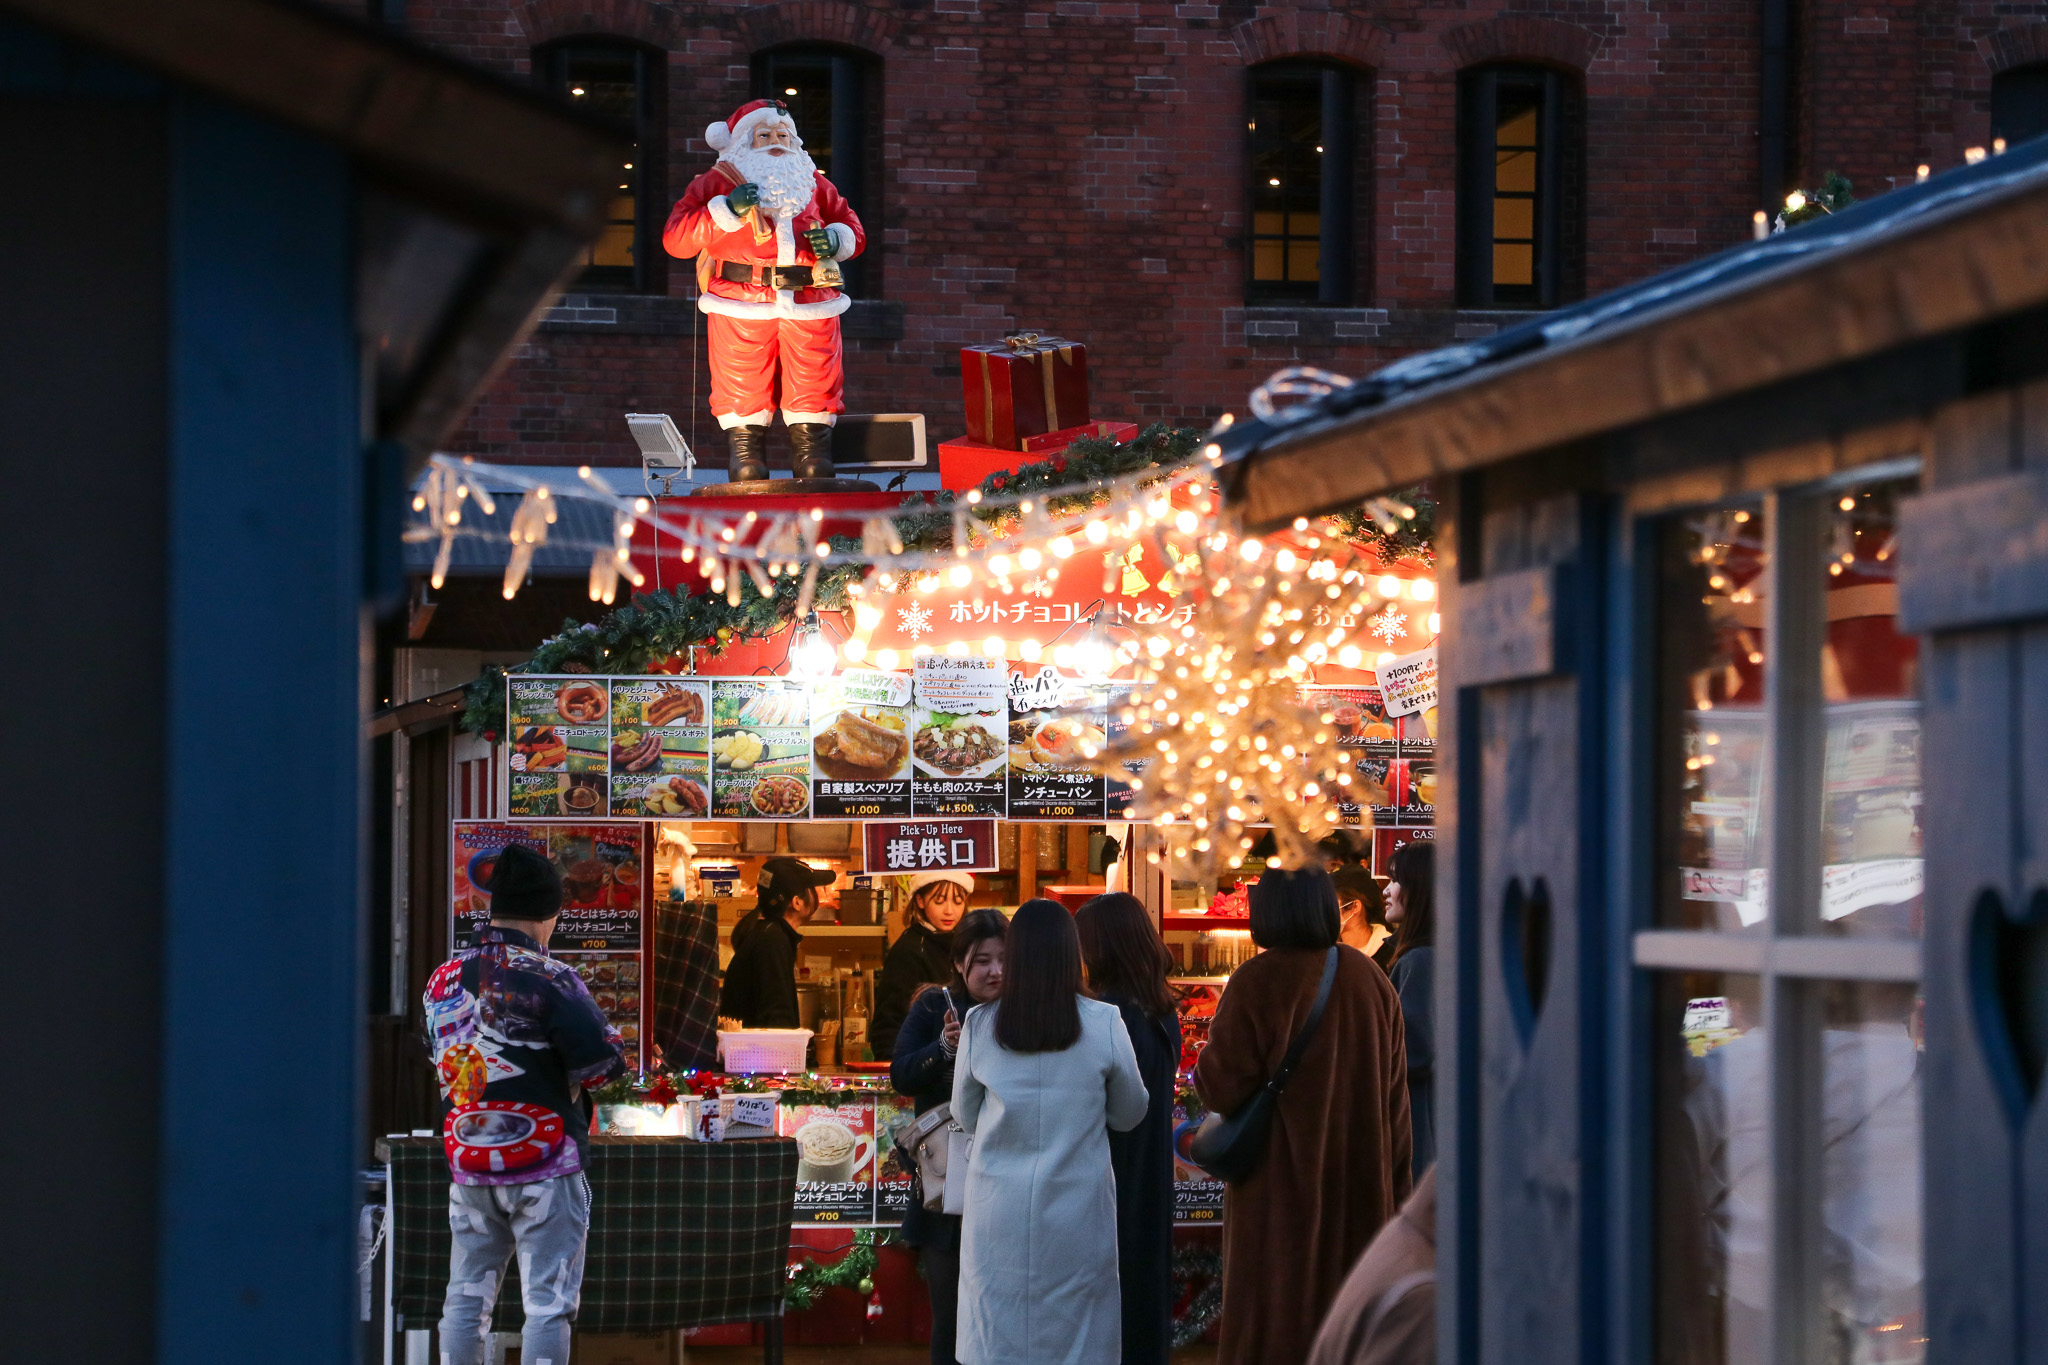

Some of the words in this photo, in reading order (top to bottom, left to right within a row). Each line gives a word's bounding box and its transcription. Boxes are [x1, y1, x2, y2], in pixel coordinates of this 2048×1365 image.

[949, 601, 1197, 624] ホットチョコレトとシチ
[553, 728, 607, 737] ミニチュロドーナツ
[1021, 773, 1094, 784] トマトソース煮込み
[820, 782, 905, 795] 自家製スペアリブ
[912, 782, 1004, 794] 牛もも肉のステーキ
[1023, 786, 1093, 799] シチューパン
[611, 808, 637, 816] ¥1,000
[845, 805, 880, 815] ¥1,000
[1040, 806, 1075, 815] ¥1,000
[900, 824, 938, 836] Pick-Up
[941, 823, 963, 834] Here
[886, 837, 975, 869] 提供口
[557, 908, 640, 920] ちごとはちみつの
[557, 921, 632, 933] ホットチョコレート
[581, 940, 607, 949] ¥700
[737, 1099, 770, 1112] わりばし
[796, 1181, 867, 1192] ブルショコラの
[815, 1212, 839, 1221] ¥700
[1191, 1210, 1214, 1219] ¥800
